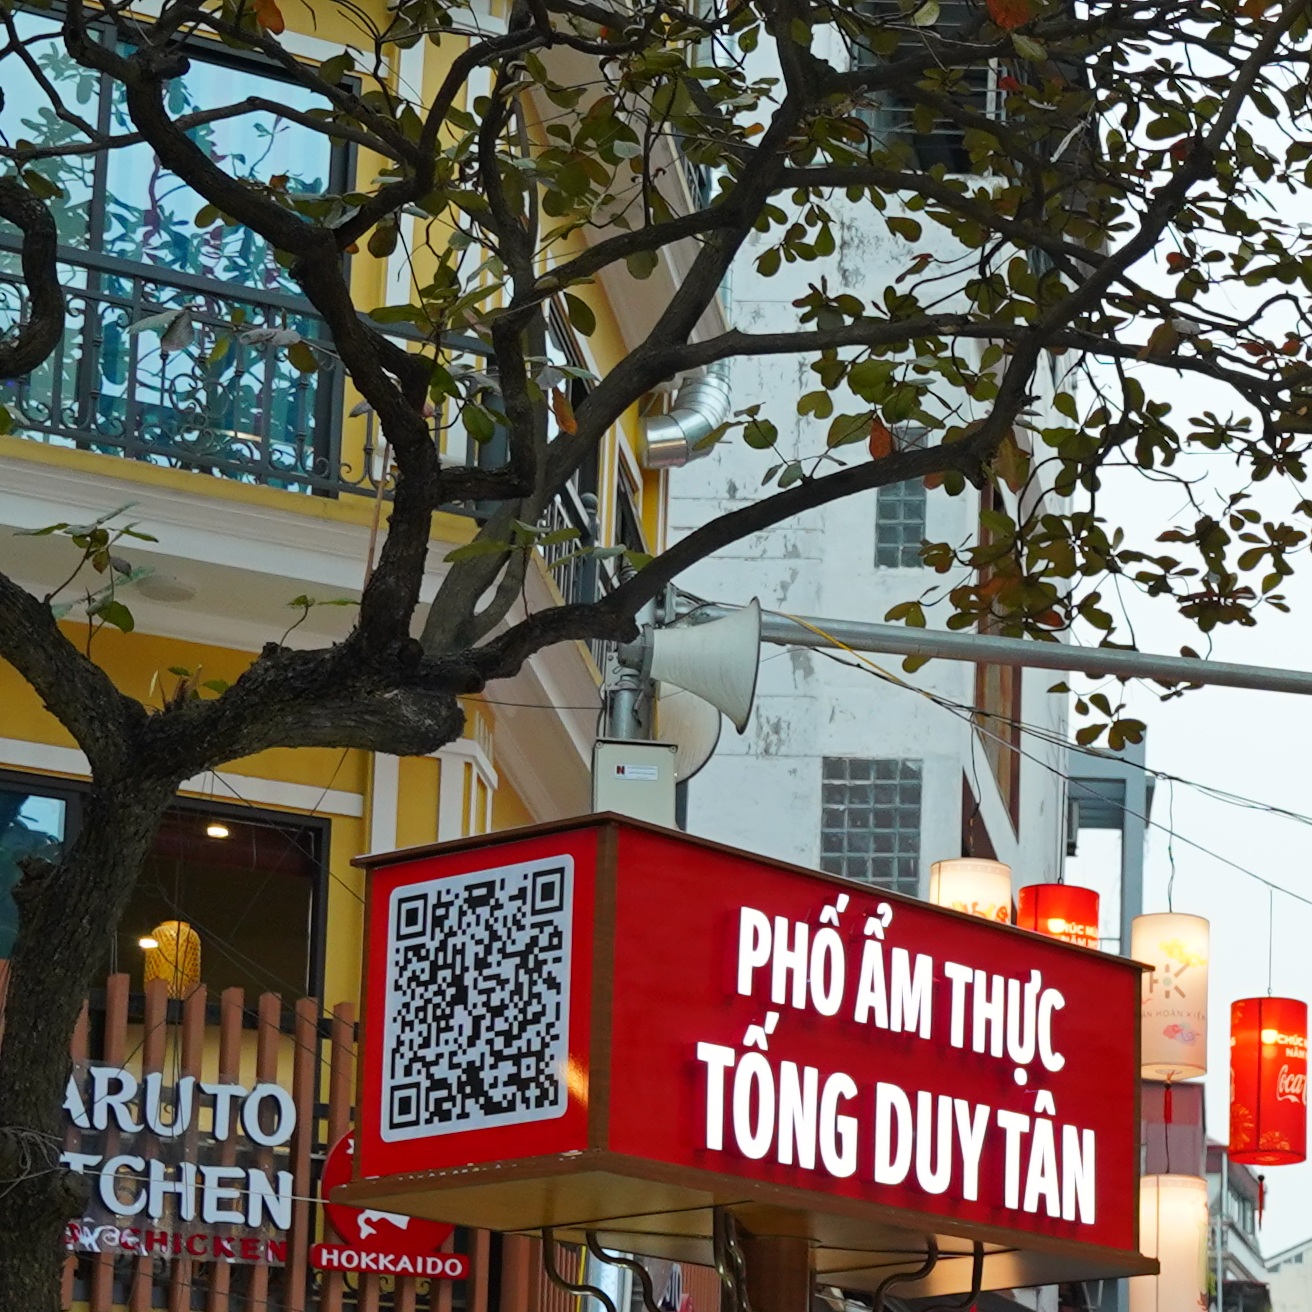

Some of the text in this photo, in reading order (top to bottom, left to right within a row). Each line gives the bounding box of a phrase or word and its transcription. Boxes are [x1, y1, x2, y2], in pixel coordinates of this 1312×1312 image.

[736, 894, 1066, 1086] PHỐ ẨM THỰC
[696, 1012, 1096, 1225] TỐNG DUY TÂN
[320, 1248, 464, 1278] HOKKAIDO
